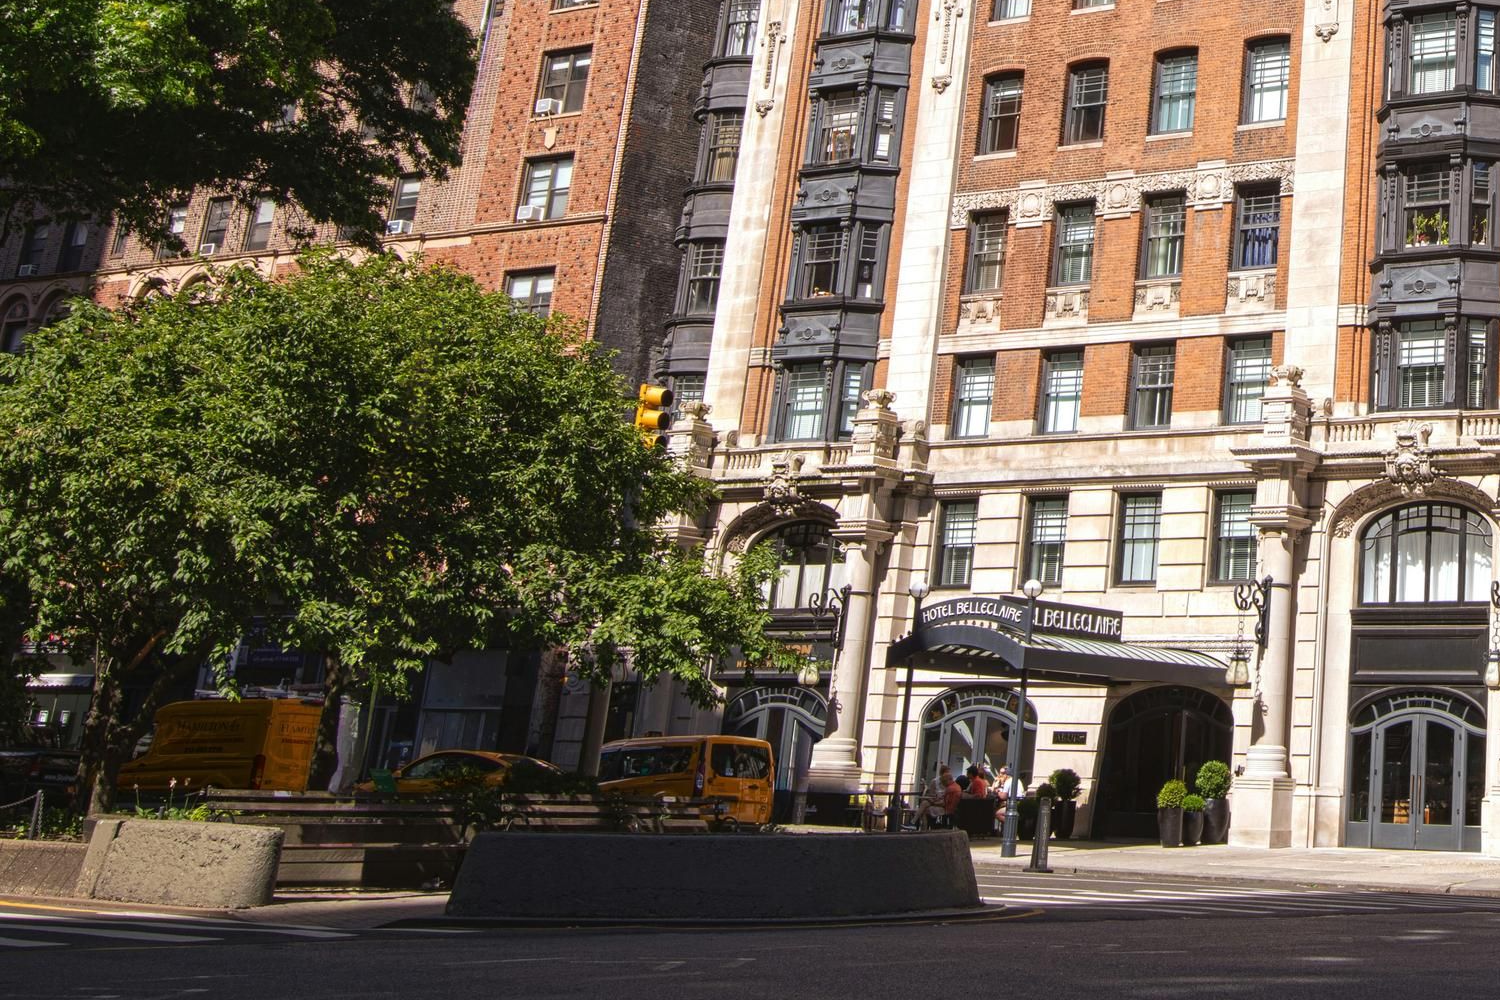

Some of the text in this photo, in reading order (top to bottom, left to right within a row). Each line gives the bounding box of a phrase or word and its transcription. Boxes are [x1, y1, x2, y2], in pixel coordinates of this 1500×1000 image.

[922, 605, 954, 624] HOTEL
[956, 601, 1023, 623] BELLECLAIRE
[1043, 608, 1121, 636] BELLECLAIRE
